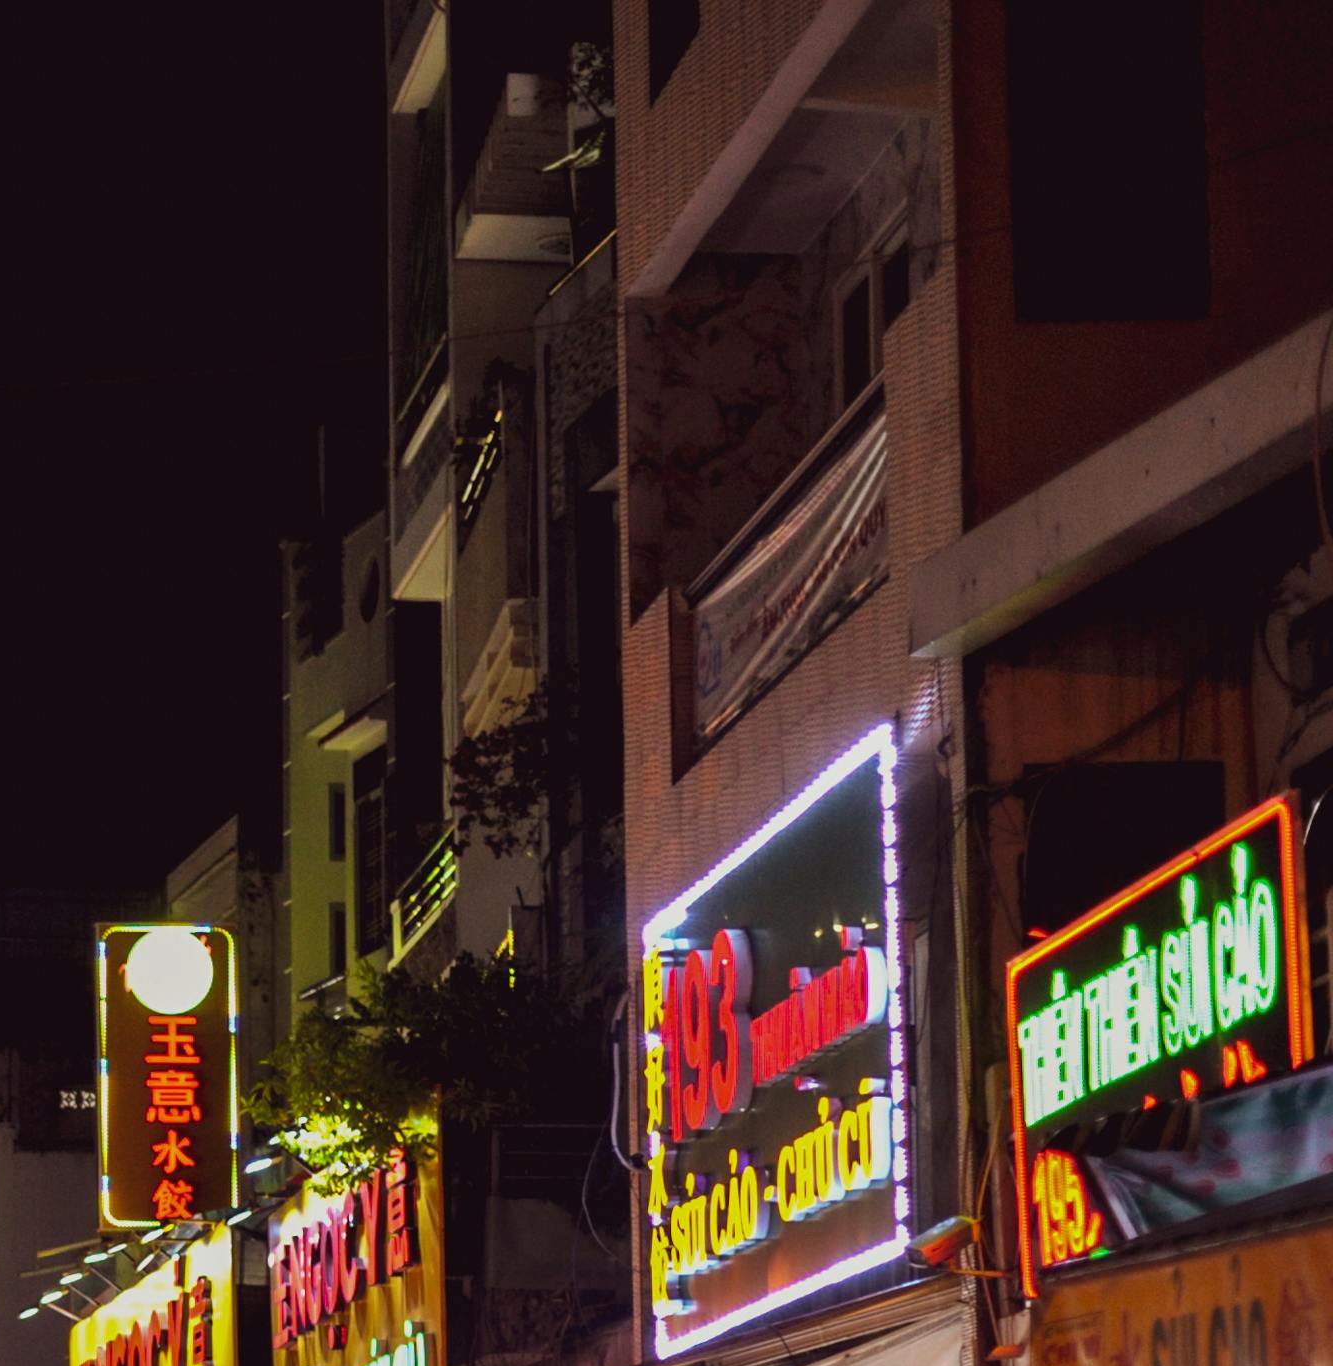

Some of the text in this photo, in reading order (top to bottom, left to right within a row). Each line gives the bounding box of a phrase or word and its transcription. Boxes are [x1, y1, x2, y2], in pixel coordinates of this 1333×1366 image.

[144, 1015, 201, 1220] 玉意水餃
[660, 928, 738, 1142] 193
[670, 1172, 707, 1273] SỦI
[710, 1149, 758, 1256] CẢO
[776, 1097, 834, 1222] CHỦ
